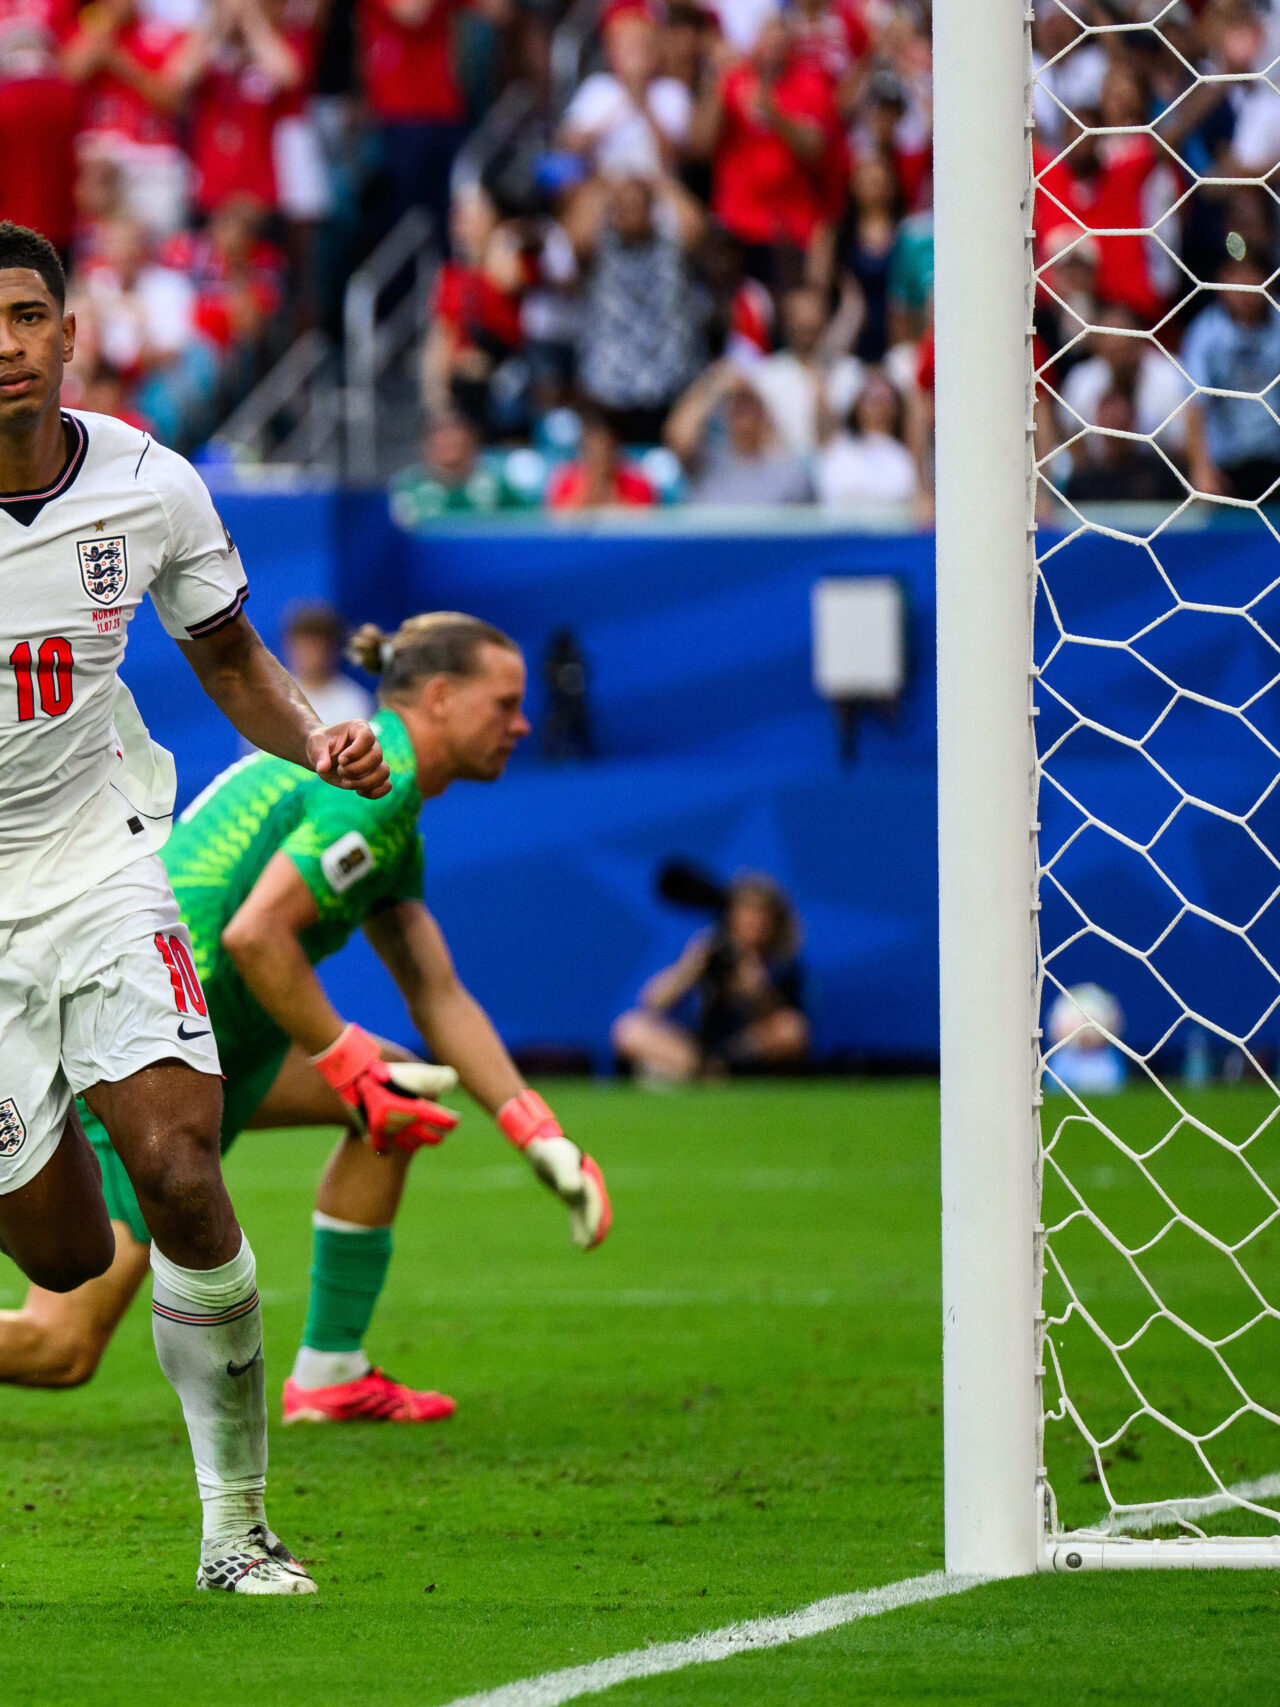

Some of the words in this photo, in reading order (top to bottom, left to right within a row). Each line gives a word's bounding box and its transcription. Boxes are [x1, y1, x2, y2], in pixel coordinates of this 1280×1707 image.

[92, 606, 122, 623] NORWAY
[9, 636, 74, 722] 10
[154, 932, 207, 1017] 10
